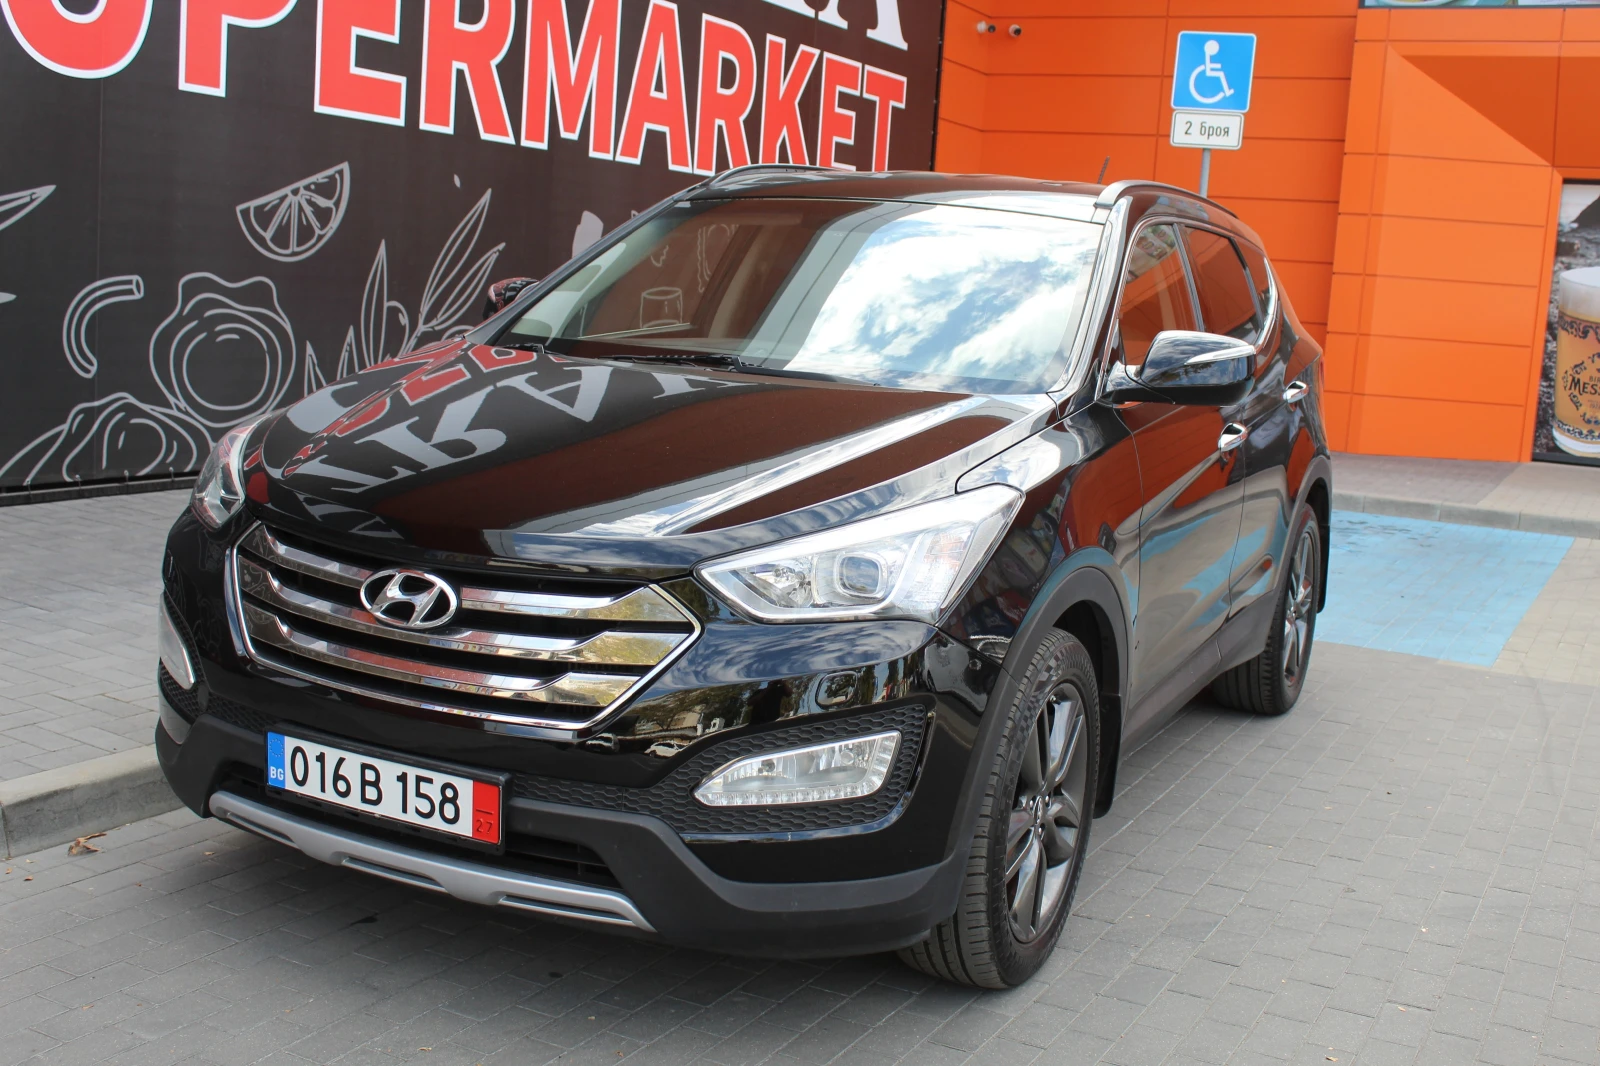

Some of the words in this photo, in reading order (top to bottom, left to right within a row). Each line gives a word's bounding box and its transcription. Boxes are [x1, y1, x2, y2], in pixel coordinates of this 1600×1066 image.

[1184, 120, 1193, 136] 2
[1200, 121, 1230, 140] броя
[269, 766, 285, 781] BG
[476, 818, 494, 834] 27
